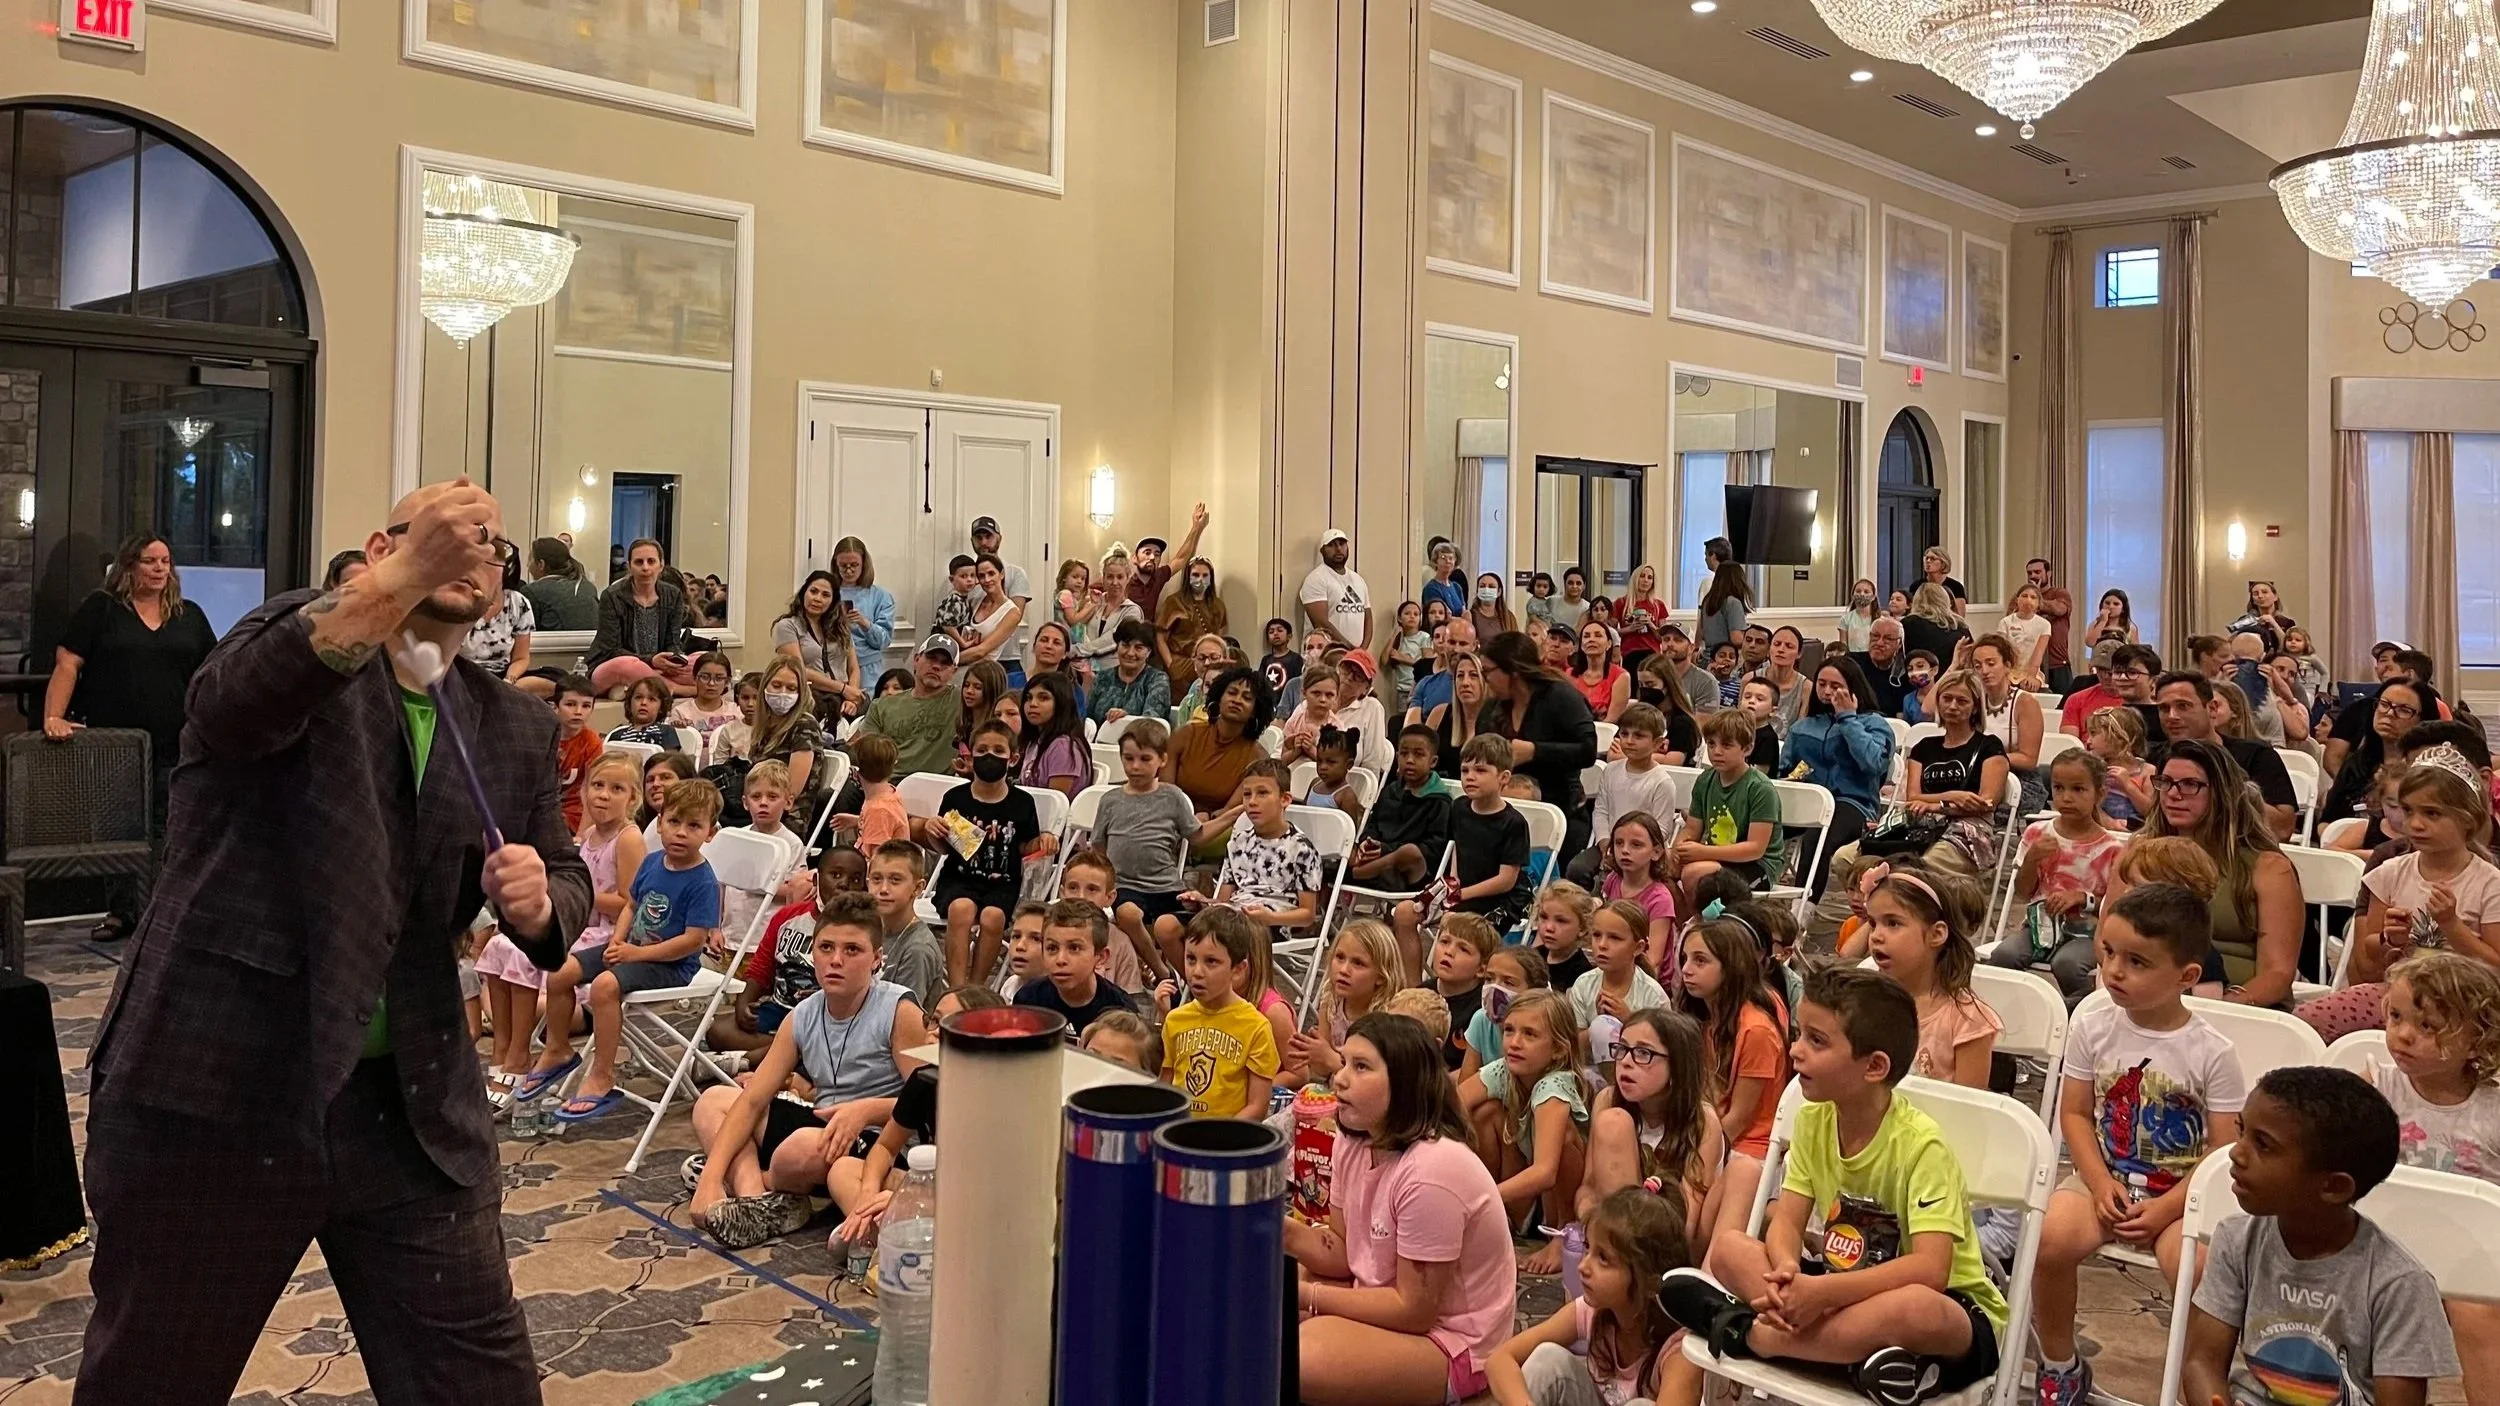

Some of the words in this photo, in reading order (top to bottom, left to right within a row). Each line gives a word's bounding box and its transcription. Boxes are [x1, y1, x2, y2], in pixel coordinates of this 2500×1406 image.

[76, 0, 134, 38] EXIT
[1923, 768, 1961, 780] GUESS
[2280, 1282, 2337, 1311] NASA
